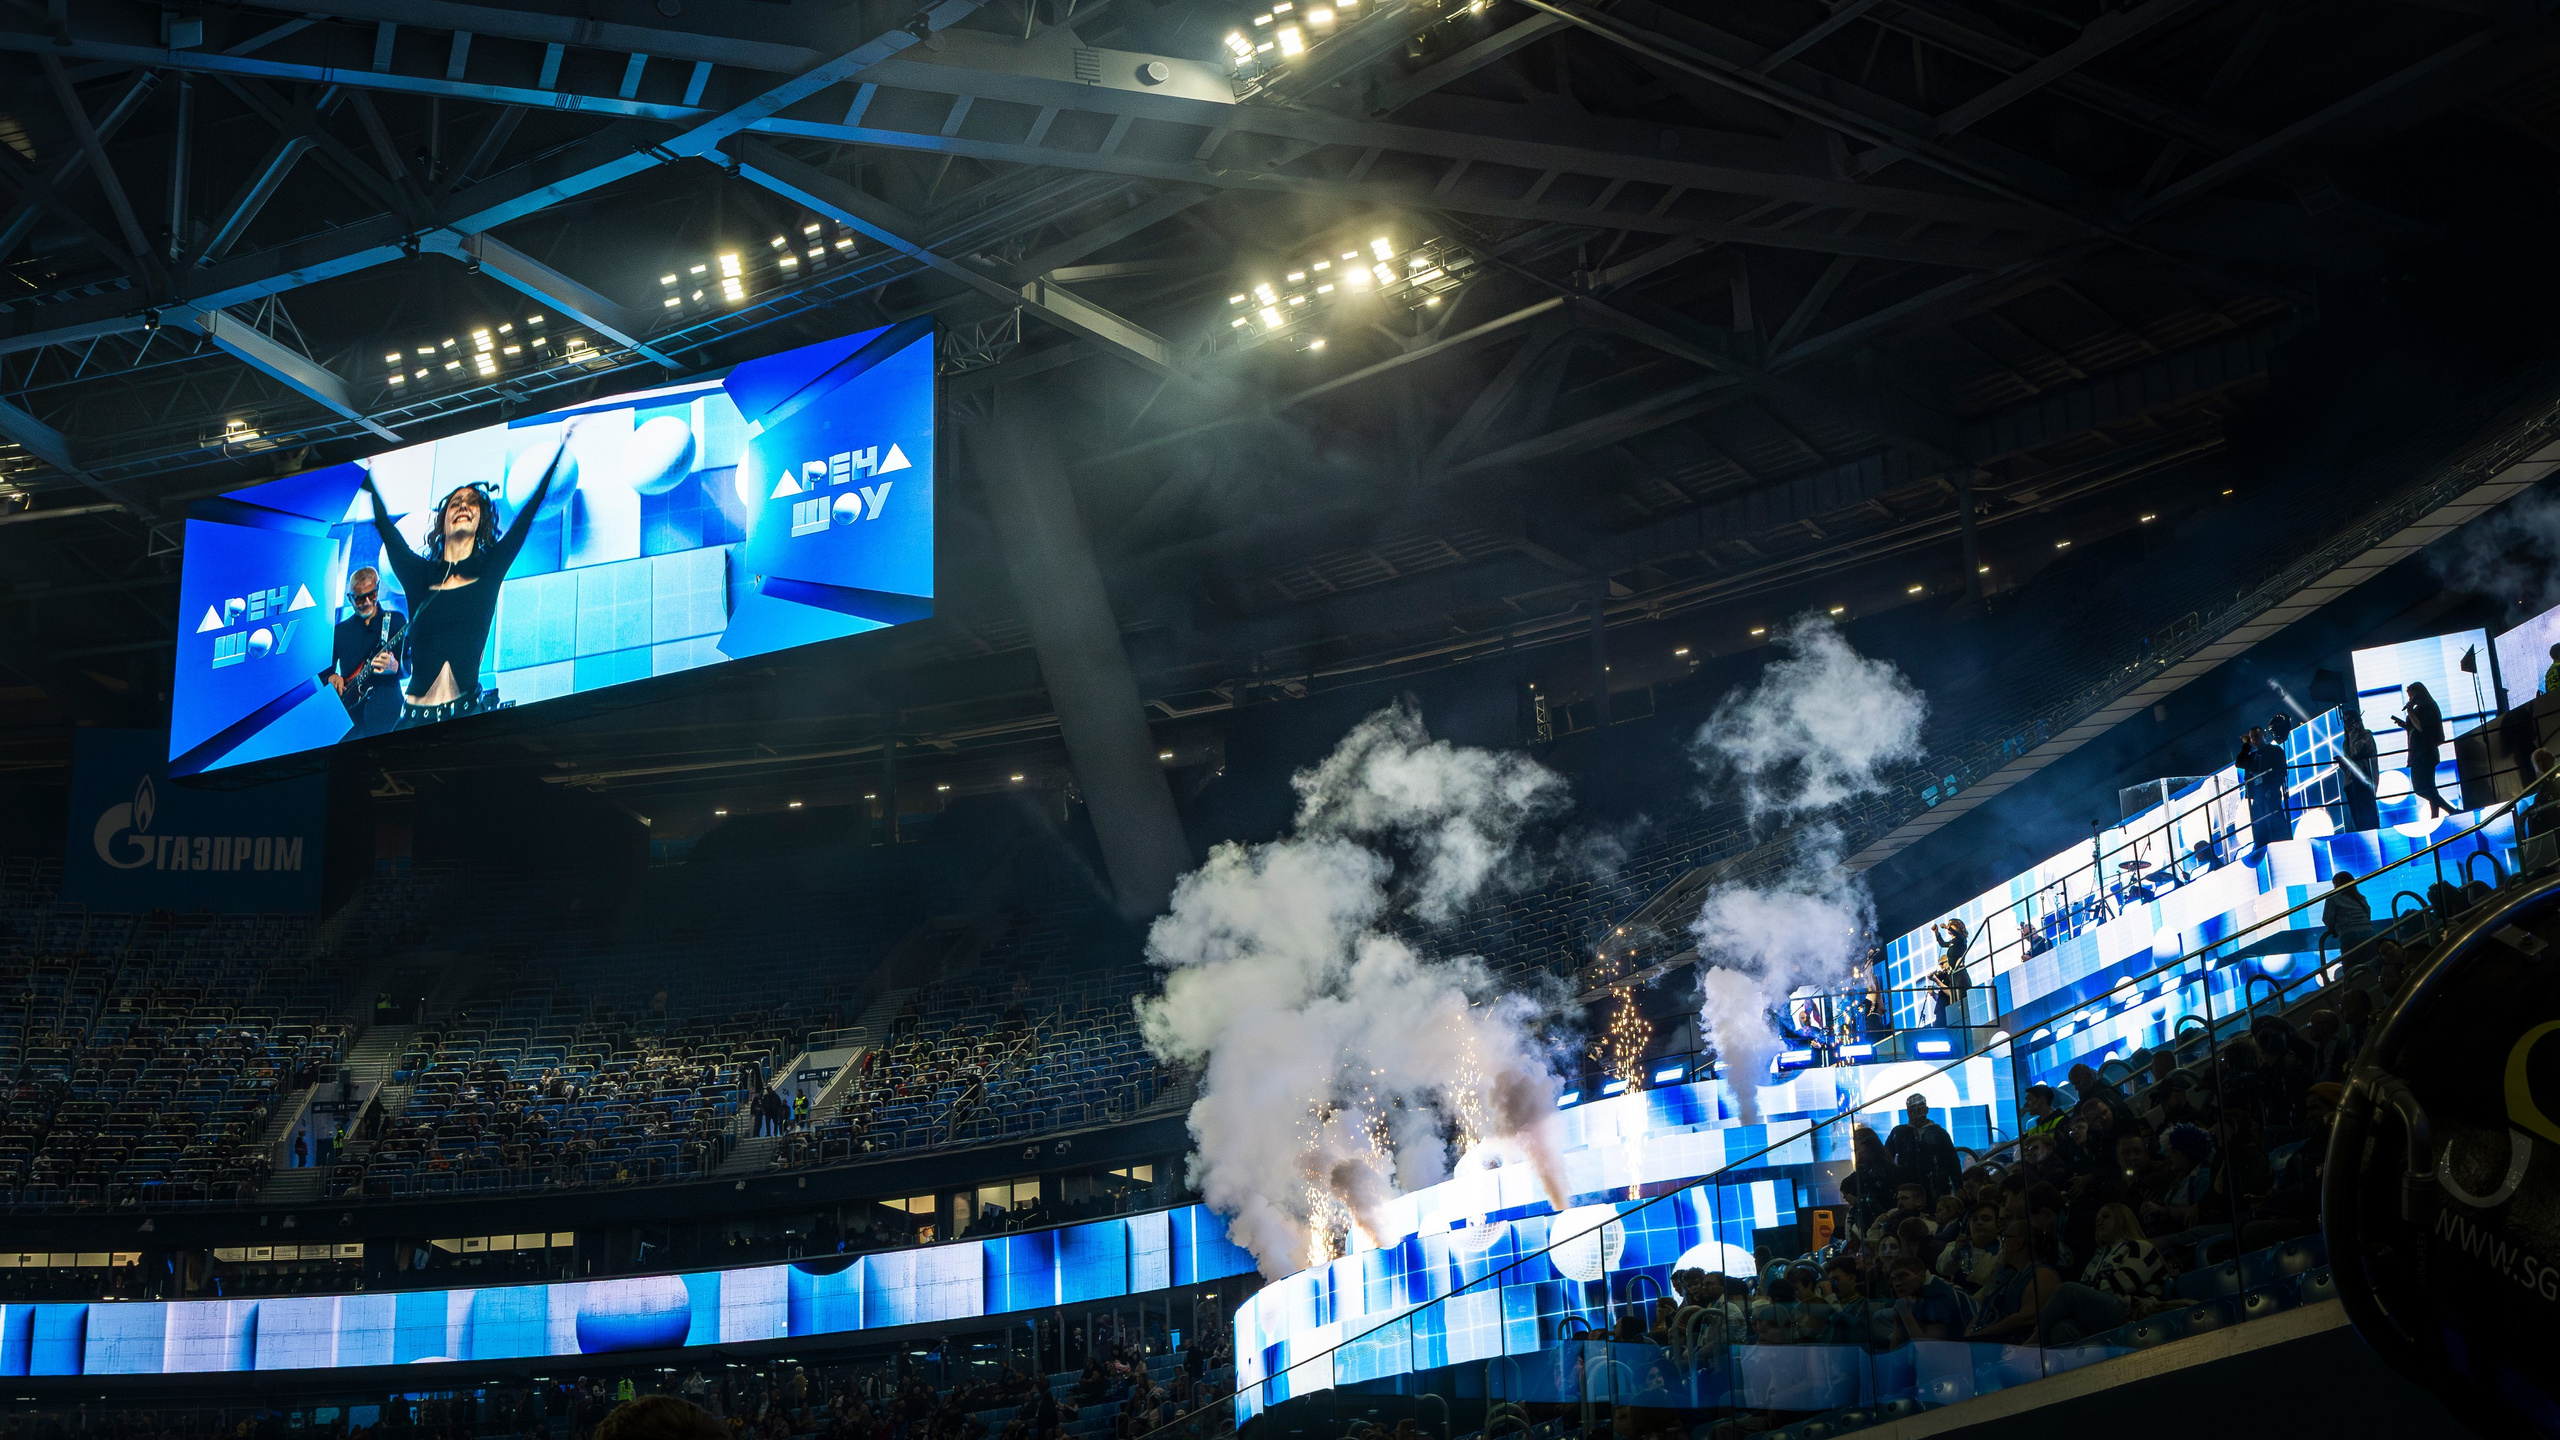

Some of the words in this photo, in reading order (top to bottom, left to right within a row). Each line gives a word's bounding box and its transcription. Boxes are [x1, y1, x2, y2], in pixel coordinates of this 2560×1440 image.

[769, 442, 912, 500] АРЕНА
[791, 481, 893, 538] ШОУ
[196, 583, 317, 634] АРЕНА
[212, 619, 300, 669] ШОУ
[156, 836, 303, 871] ГАЗПРОМ
